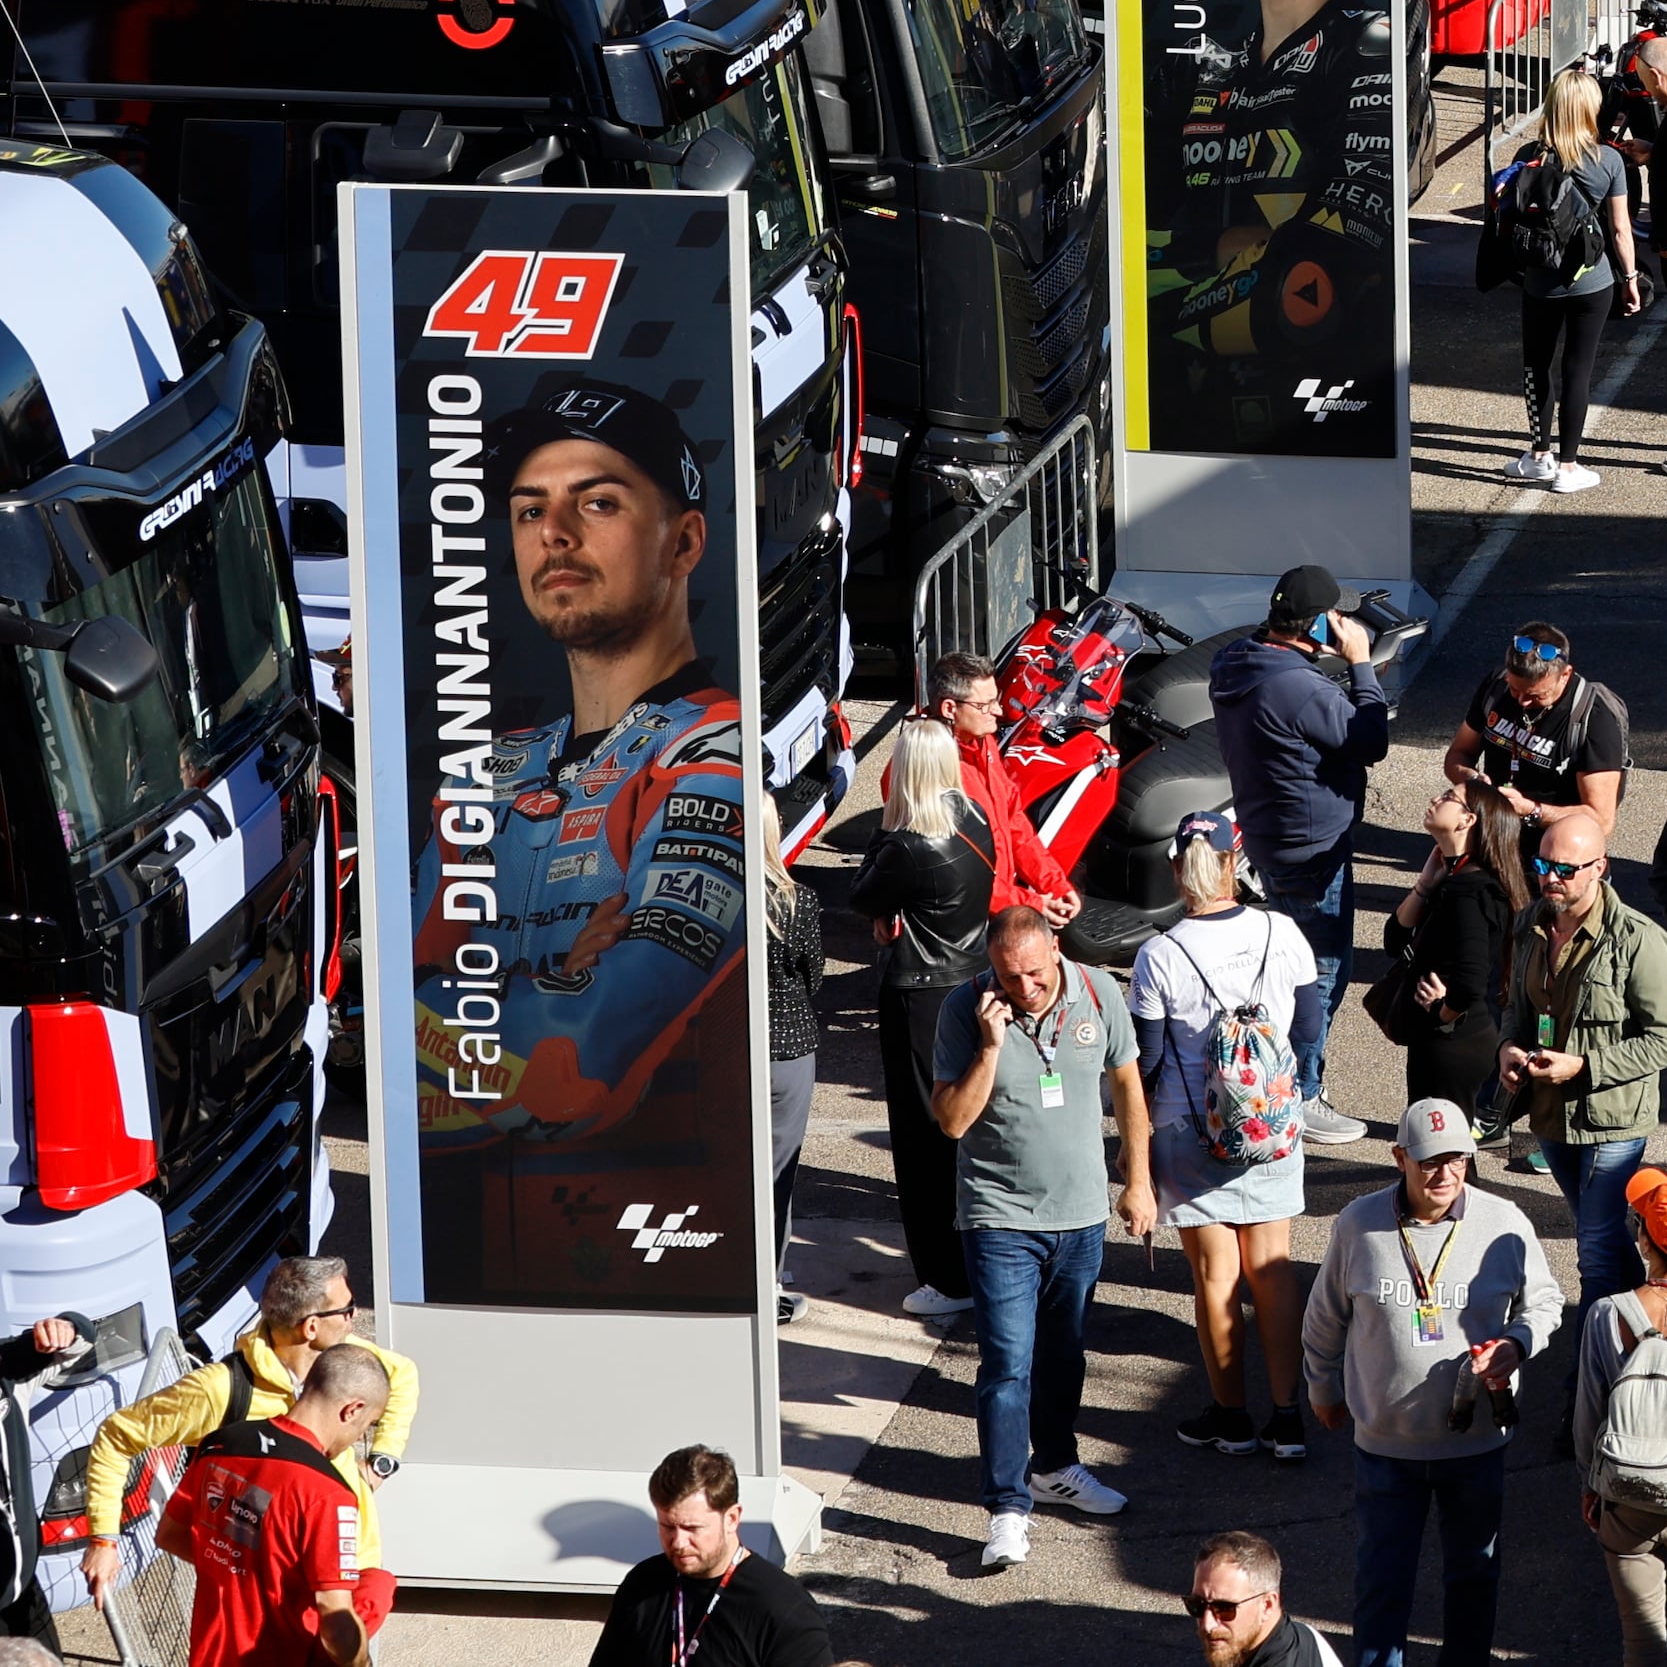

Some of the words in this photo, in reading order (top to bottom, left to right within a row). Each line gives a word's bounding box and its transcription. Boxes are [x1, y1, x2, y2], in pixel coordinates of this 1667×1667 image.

[422, 249, 627, 361] 49
[426, 373, 497, 846] GIANNANTONIO
[668, 796, 731, 823] BOLD
[666, 819, 726, 834] RIDERS
[440, 862, 498, 923] DI
[703, 889, 729, 908] motors
[704, 878, 732, 898] gate
[441, 942, 503, 1101] Fabio
[1427, 1110, 1446, 1133] B
